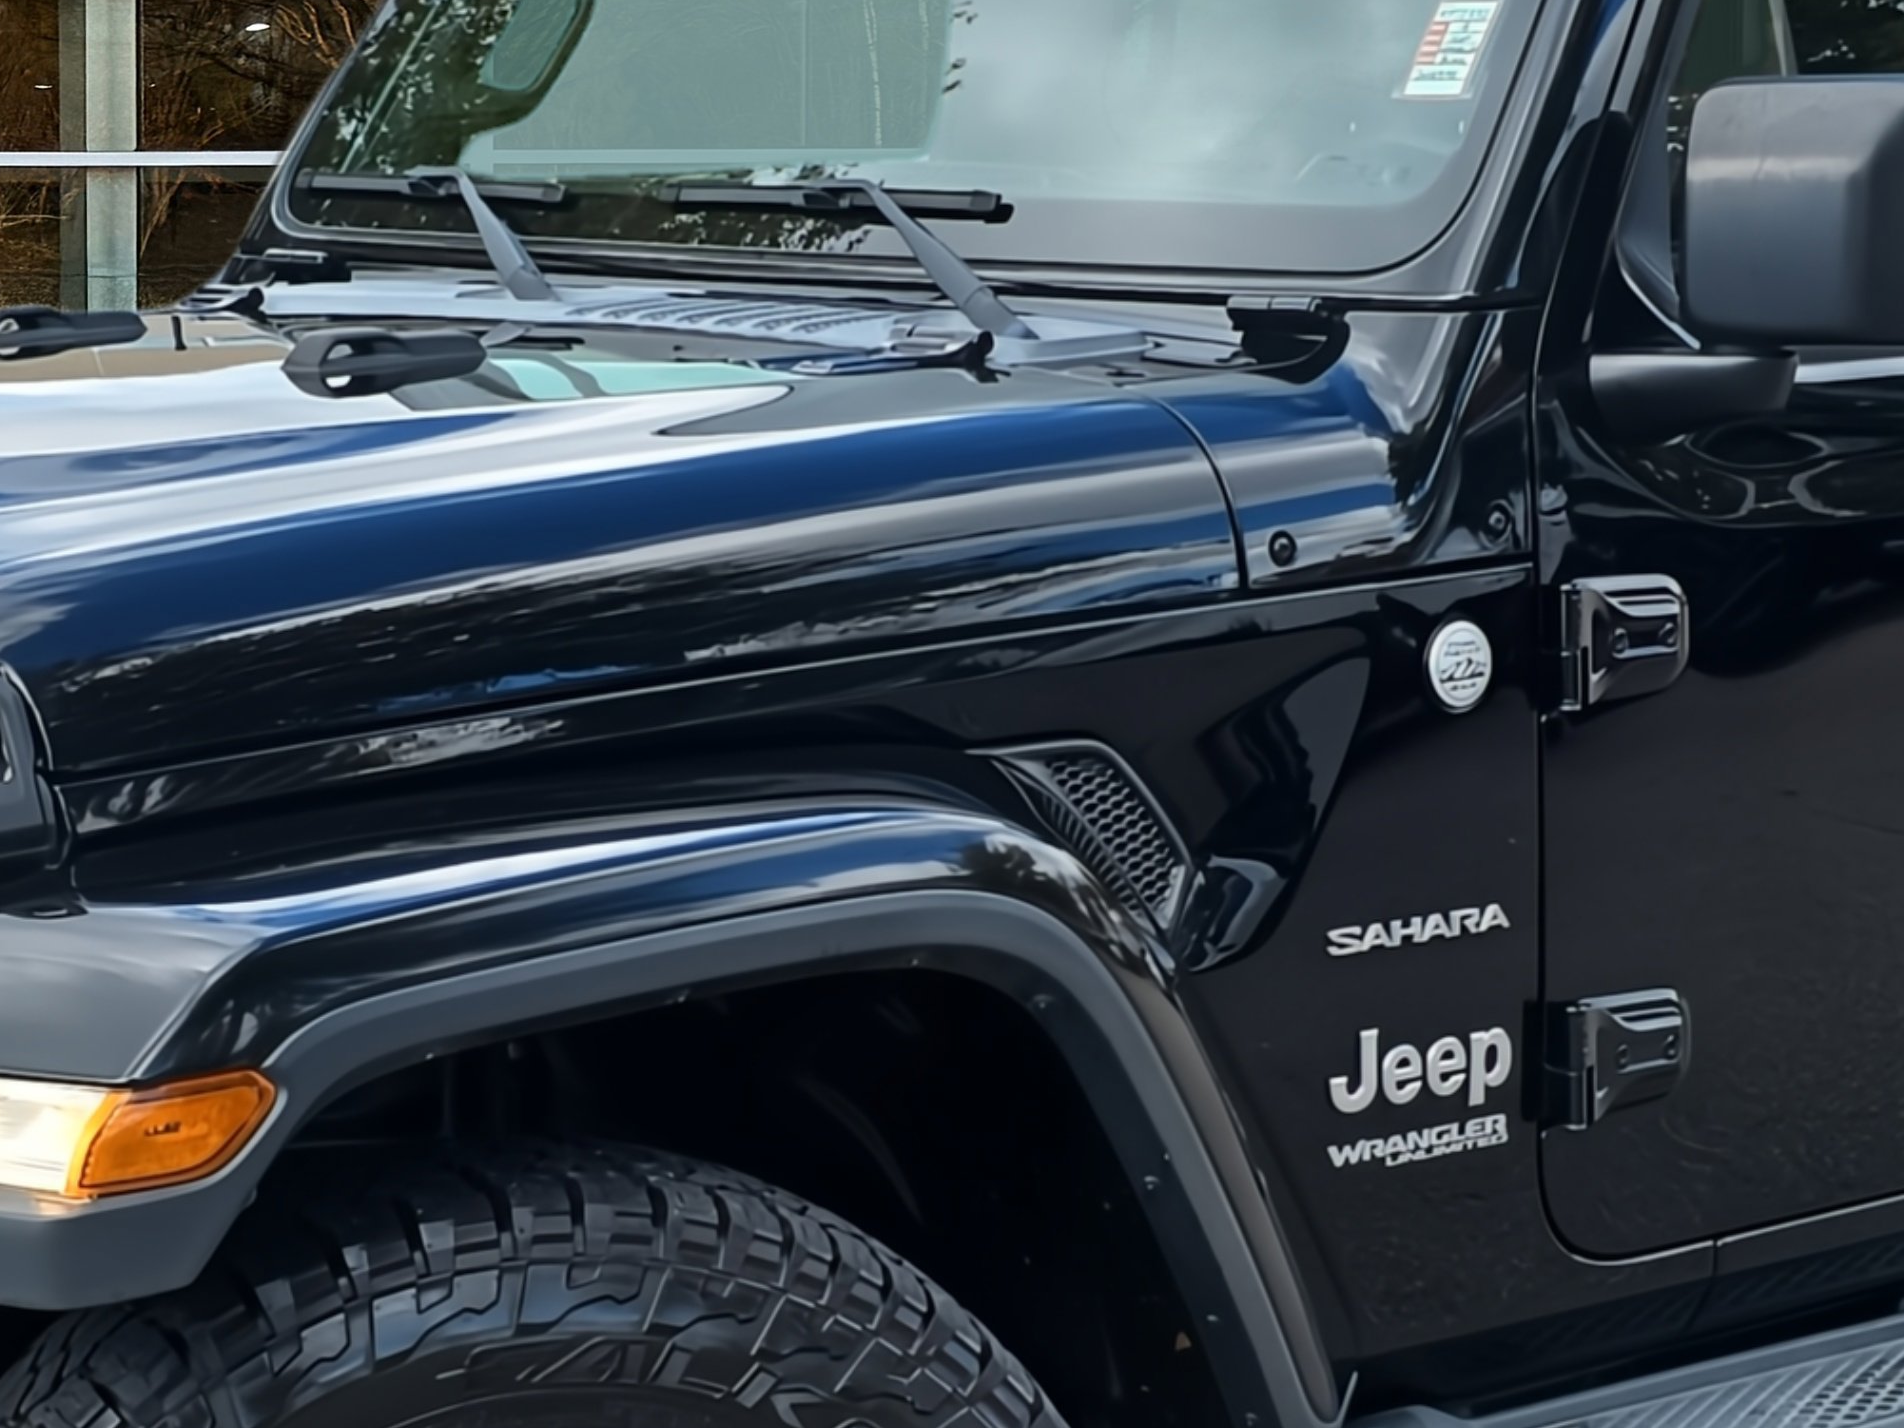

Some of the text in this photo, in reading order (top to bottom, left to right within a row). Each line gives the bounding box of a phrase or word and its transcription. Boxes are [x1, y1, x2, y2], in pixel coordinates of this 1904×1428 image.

[1326, 903, 1511, 956] SAHARA
[1329, 1027, 1513, 1114] Jeep
[1327, 1113, 1508, 1168] WRANGLER
[1385, 1133, 1509, 1167] UNLIMITED
